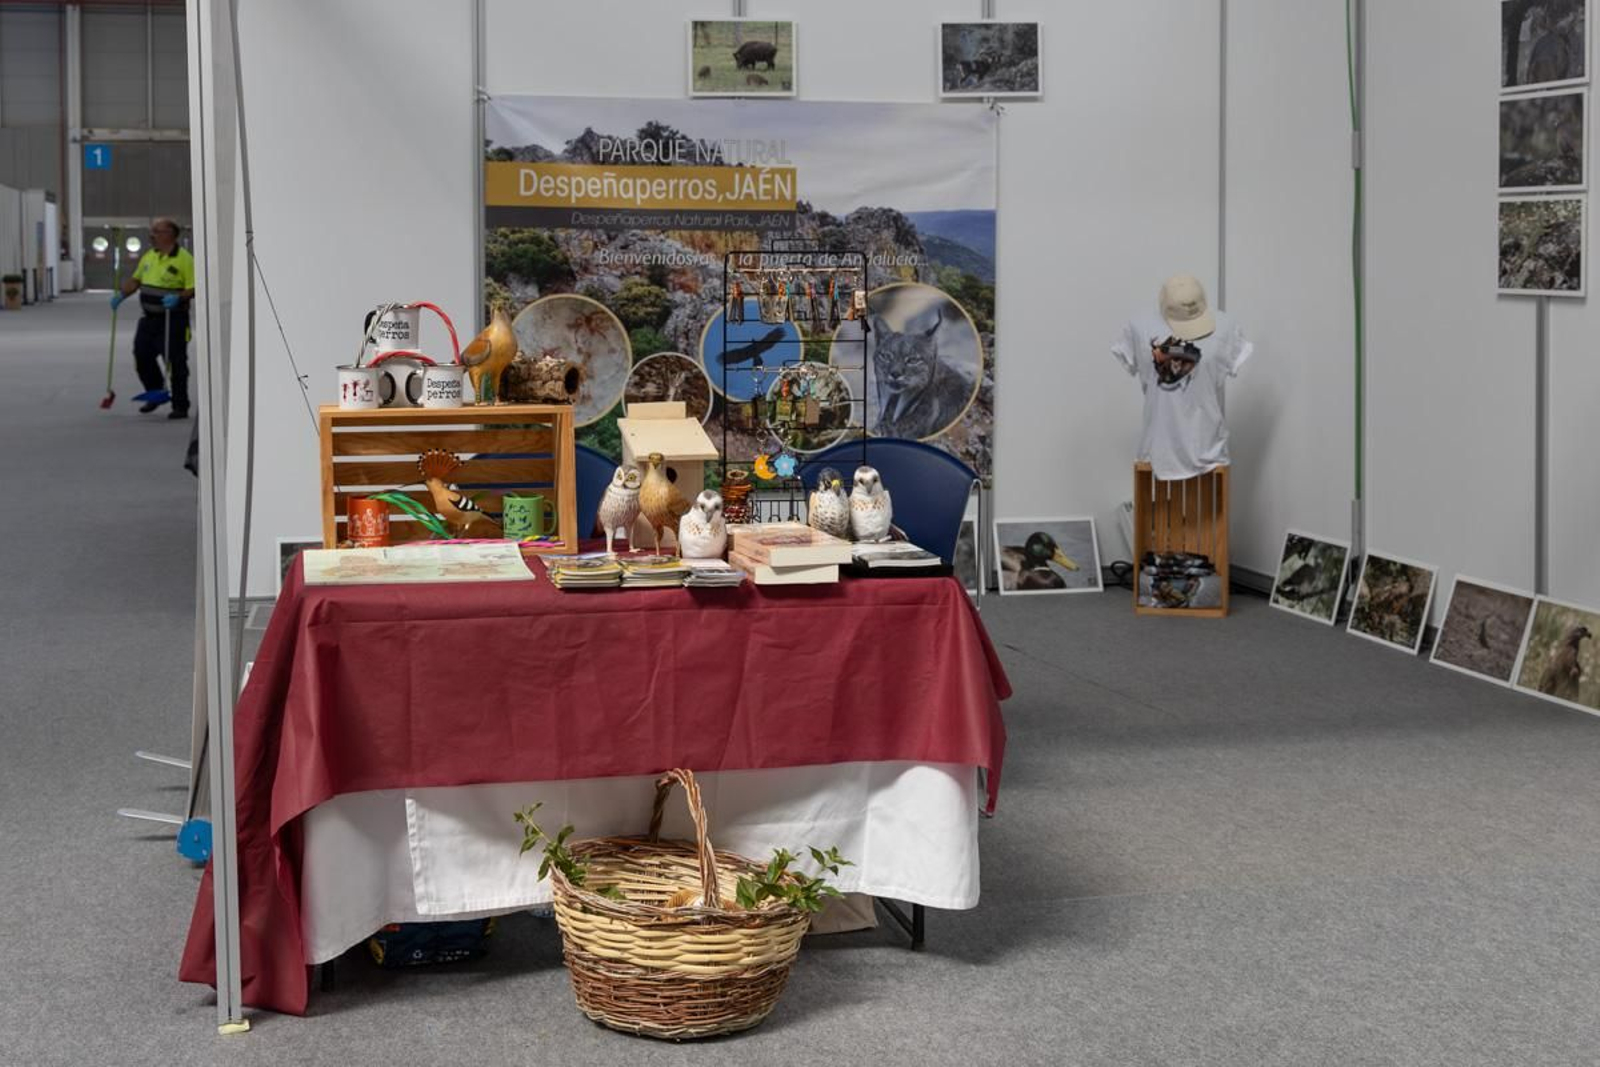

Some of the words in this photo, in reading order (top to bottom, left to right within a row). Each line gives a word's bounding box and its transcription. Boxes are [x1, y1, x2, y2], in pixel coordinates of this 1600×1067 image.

[93, 147, 103, 166] 1
[600, 138, 687, 163] PARQUE
[696, 139, 792, 165] NATURAL
[673, 213, 722, 227] Natural
